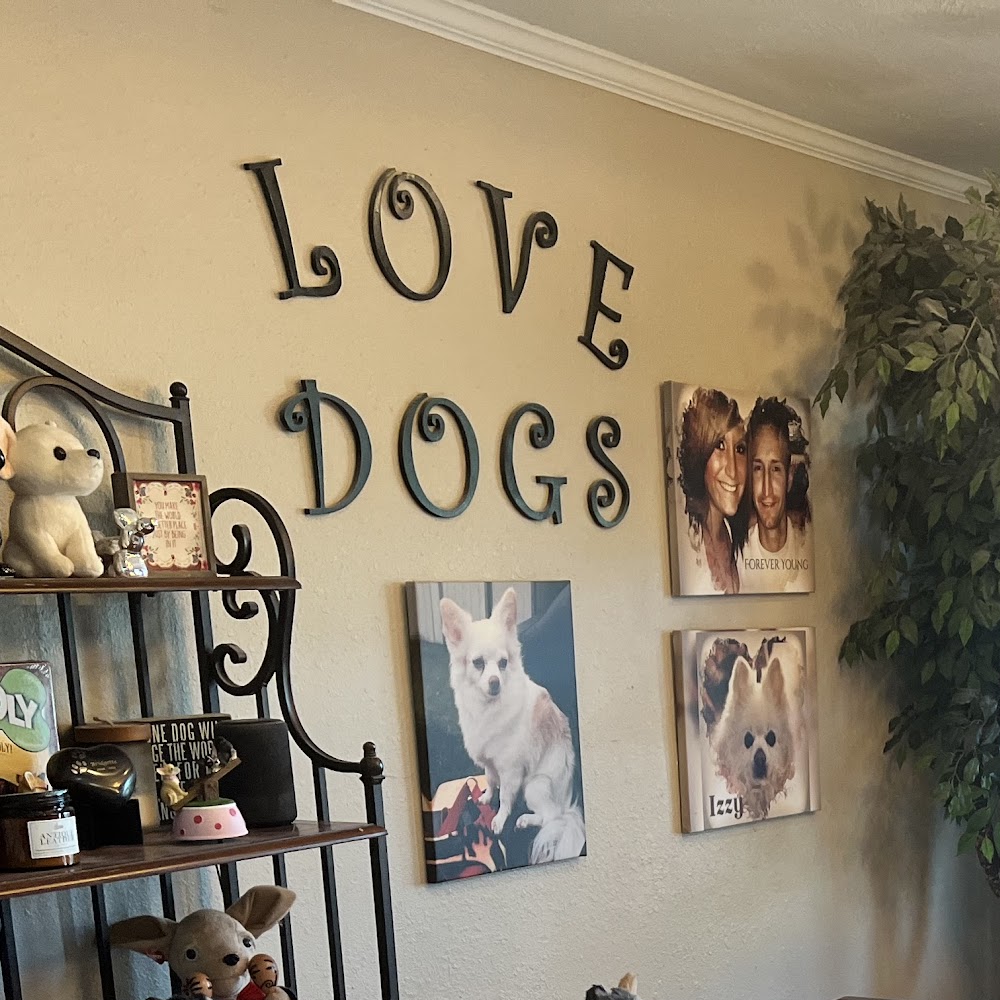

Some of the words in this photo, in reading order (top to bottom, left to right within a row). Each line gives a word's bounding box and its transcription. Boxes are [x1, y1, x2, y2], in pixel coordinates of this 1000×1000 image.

[243, 158, 634, 370] LOVE
[280, 379, 631, 528] DOGS
[157, 520, 172, 530] ETTER
[744, 558, 781, 570] FOREVER
[781, 558, 809, 570] YOUNG
[151, 723, 168, 743] NE
[171, 721, 195, 743] DOG
[198, 720, 217, 740] WI
[0, 741, 13, 755] LY!
[151, 743, 164, 763] GE
[167, 741, 188, 762] THE
[709, 795, 744, 820] Izzy
